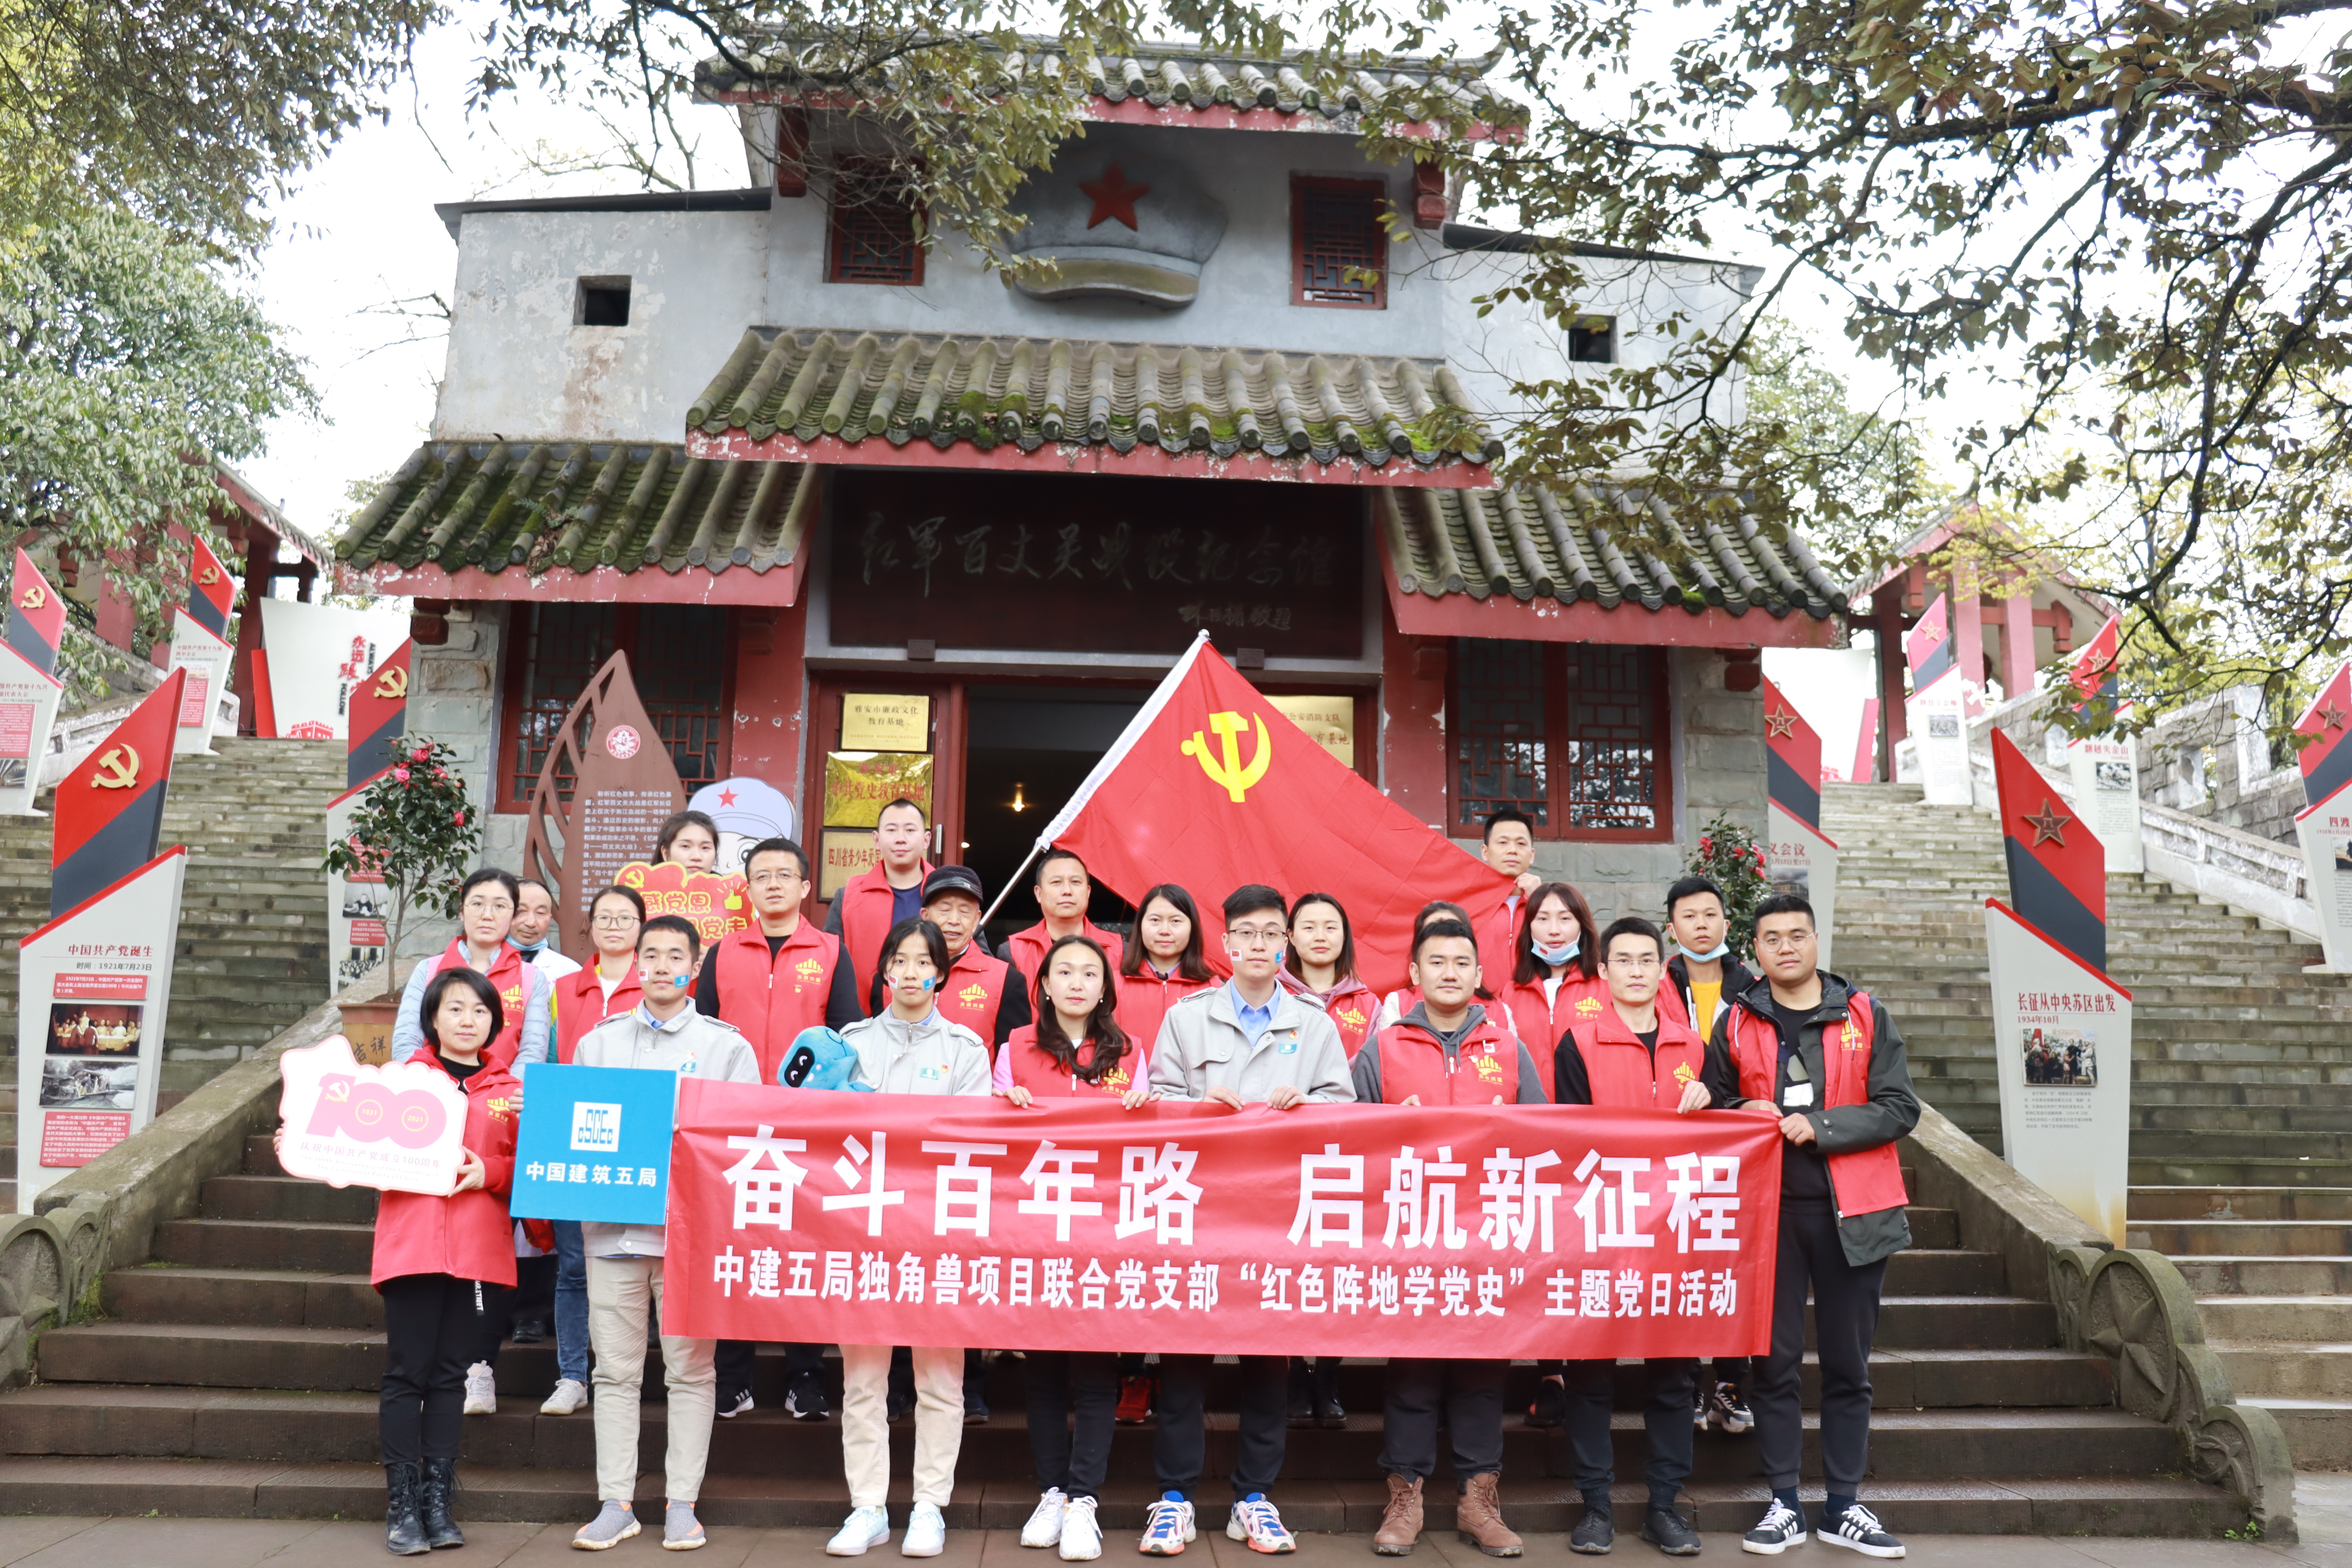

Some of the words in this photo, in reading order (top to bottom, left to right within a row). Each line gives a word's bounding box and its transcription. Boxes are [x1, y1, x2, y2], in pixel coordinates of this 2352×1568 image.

[855, 704, 918, 715] 雅安市廉政文化
[869, 717, 904, 726] 教育基地
[1305, 731, 1350, 745] 育基地
[640, 891, 712, 915] 感党恩
[68, 944, 154, 957] 中国共产党诞生
[2018, 992, 2116, 1013] 长征从中央苏区出发
[2018, 1015, 2059, 1024] 1934年10月
[361, 1108, 377, 1116] 1921
[300, 1141, 441, 1169] 庆祝中国共产党成立100周年
[526, 1161, 657, 1187] 中国建筑五局
[722, 1123, 1203, 1245] 奋斗百年路
[1286, 1143, 1741, 1254] 启航新征程
[713, 1245, 1219, 1312] 中建五局独角兽项目联合党支部
[1544, 1268, 1737, 1318] 主题党日活动
